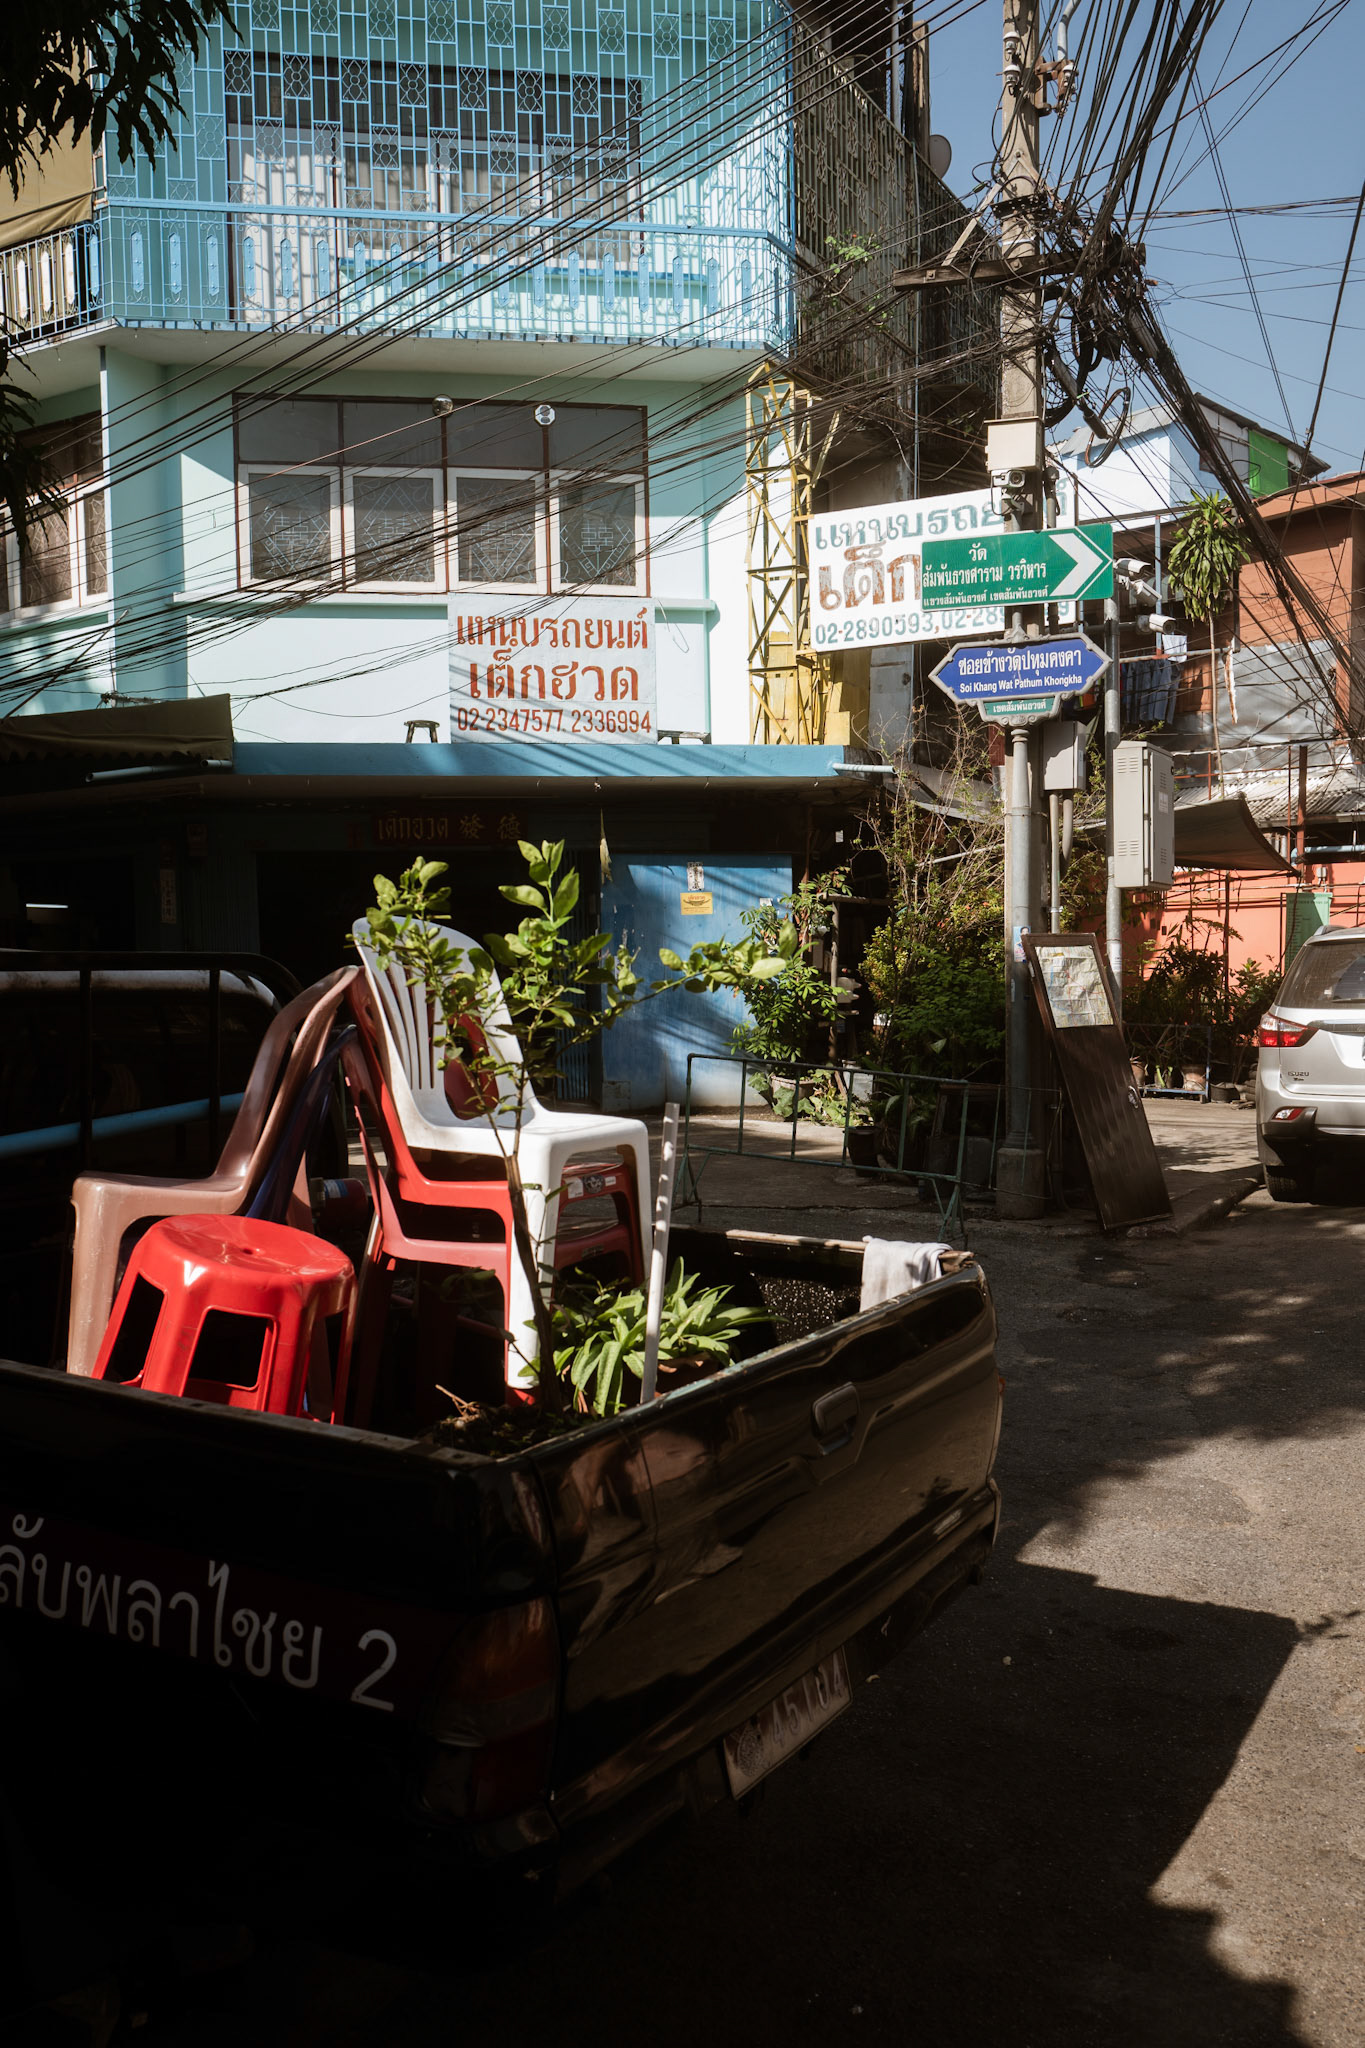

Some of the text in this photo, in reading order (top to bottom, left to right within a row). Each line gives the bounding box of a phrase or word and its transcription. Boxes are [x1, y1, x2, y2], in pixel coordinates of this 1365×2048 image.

[968, 542, 987, 562] วัด
[922, 558, 1047, 588] สัมพันธวงศาราม วรวิหาร
[457, 607, 648, 649] แหนบรถยนต์
[470, 648, 638, 701] เต็กฮวด
[958, 647, 1082, 676] ซอยข้างวัดปทุมคงคา
[960, 674, 1082, 693] Soi Khang Wat Pathum Khongkha
[571, 709, 651, 733] 2336994
[0, 1514, 397, 1711] ลับพลาไชย 2
